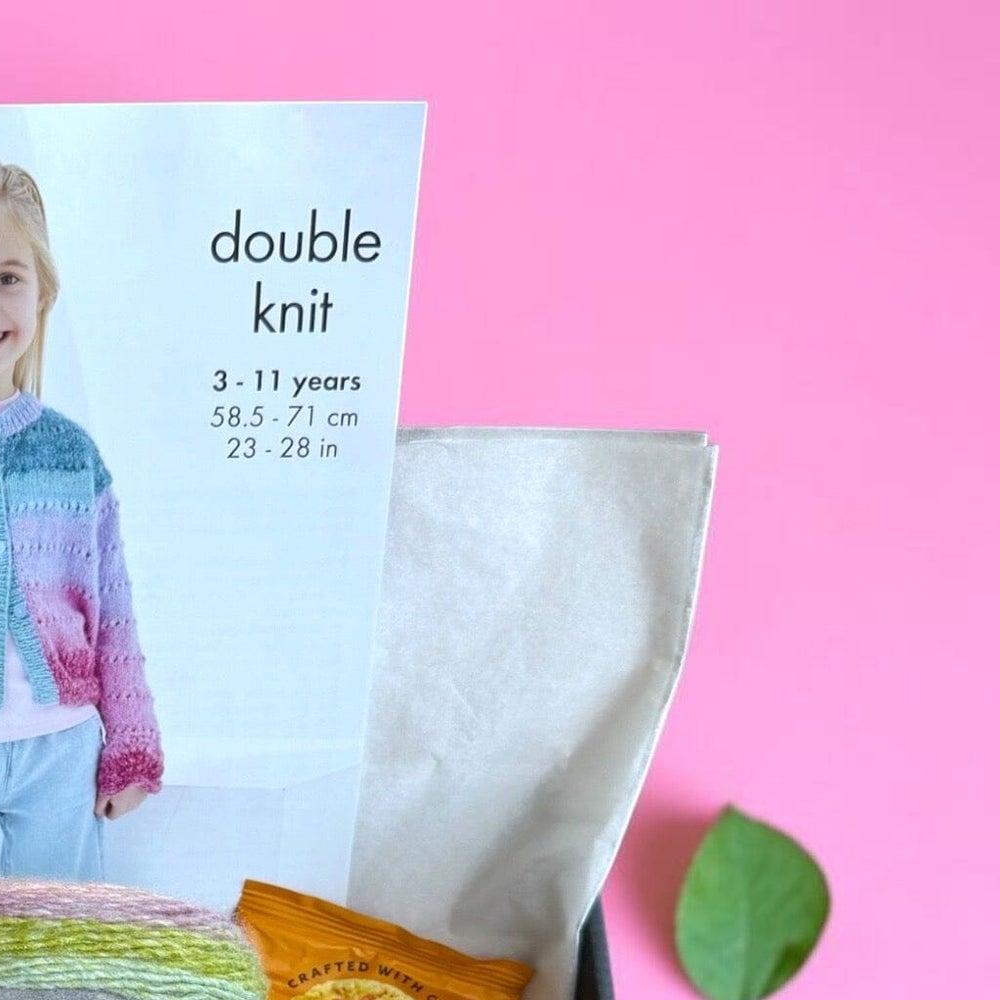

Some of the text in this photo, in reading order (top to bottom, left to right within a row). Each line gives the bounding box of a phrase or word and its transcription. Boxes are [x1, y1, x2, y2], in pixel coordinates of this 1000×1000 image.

[210, 208, 382, 264] double
[253, 281, 334, 334] knit
[212, 369, 228, 392] 3
[254, 369, 280, 392] 11
[292, 374, 362, 398] years
[210, 405, 265, 428] 58.5
[286, 405, 315, 427] 71
[327, 411, 359, 427] cm
[226, 437, 257, 459] 23
[279, 436, 311, 458] 28
[319, 438, 338, 458] in
[287, 961, 370, 989] CRAFTED
[378, 964, 425, 993] WITH
